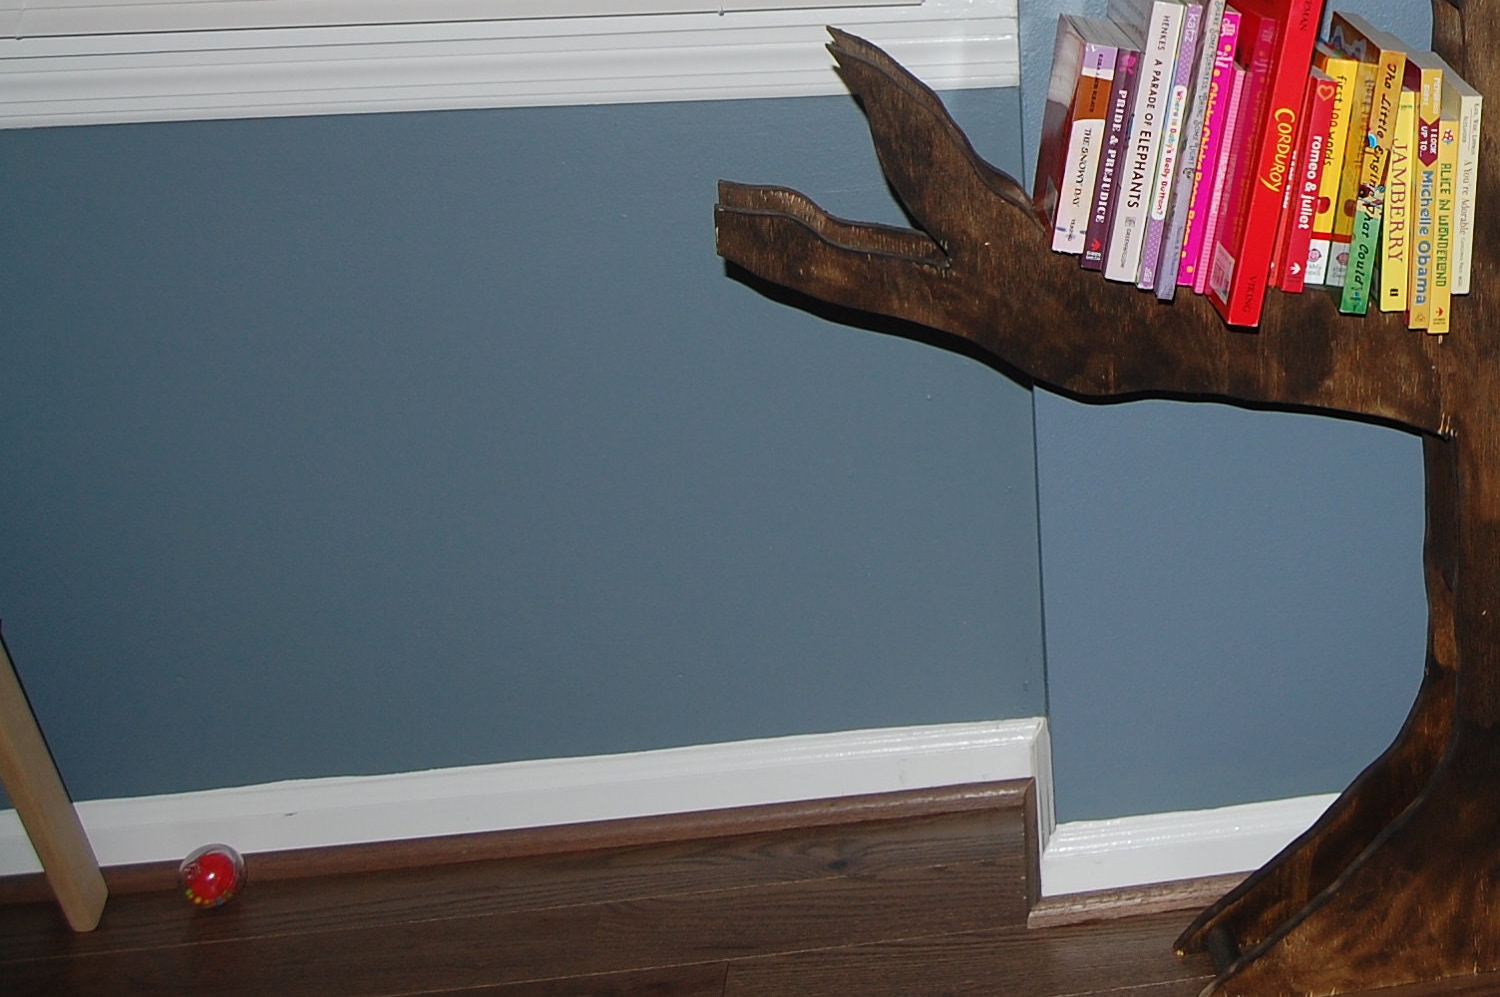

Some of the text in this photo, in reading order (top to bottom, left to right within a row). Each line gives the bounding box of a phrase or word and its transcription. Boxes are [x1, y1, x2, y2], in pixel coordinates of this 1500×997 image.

[1156, 14, 1172, 52] HENKES
[1182, 12, 1199, 44] katz
[1205, 28, 1220, 51] SOME
[1382, 62, 1397, 90] The
[1170, 90, 1185, 118] Where
[1323, 74, 1347, 168] first 100 words
[1373, 93, 1392, 139] Little
[1125, 58, 1164, 209] A PARADE OF ELEPHANTS
[1161, 127, 1178, 155] Baby's
[1189, 119, 1203, 142] SOME
[1258, 105, 1296, 193] CORDUROY
[1420, 126, 1430, 139] UP
[1428, 133, 1437, 154] LOOK
[1070, 126, 1092, 208] THE SNOWY DAY
[1093, 88, 1128, 224] PRIDE & PREJUDICE
[1158, 156, 1173, 179] Belly
[1184, 141, 1199, 165] LIGHT
[1362, 144, 1384, 199] Engine
[1293, 134, 1322, 230] romeo & juliet
[1437, 162, 1452, 195] ALICE
[1461, 167, 1473, 195] You're
[1153, 180, 1169, 216] Button?
[1384, 138, 1410, 262] JAMBERRY
[1437, 198, 1450, 211] IN
[1358, 201, 1376, 238] That
[1458, 198, 1472, 236] Adorable
[1413, 169, 1435, 305] Michelle Obama
[1351, 243, 1370, 284] Could
[1241, 274, 1257, 314] VIKING
